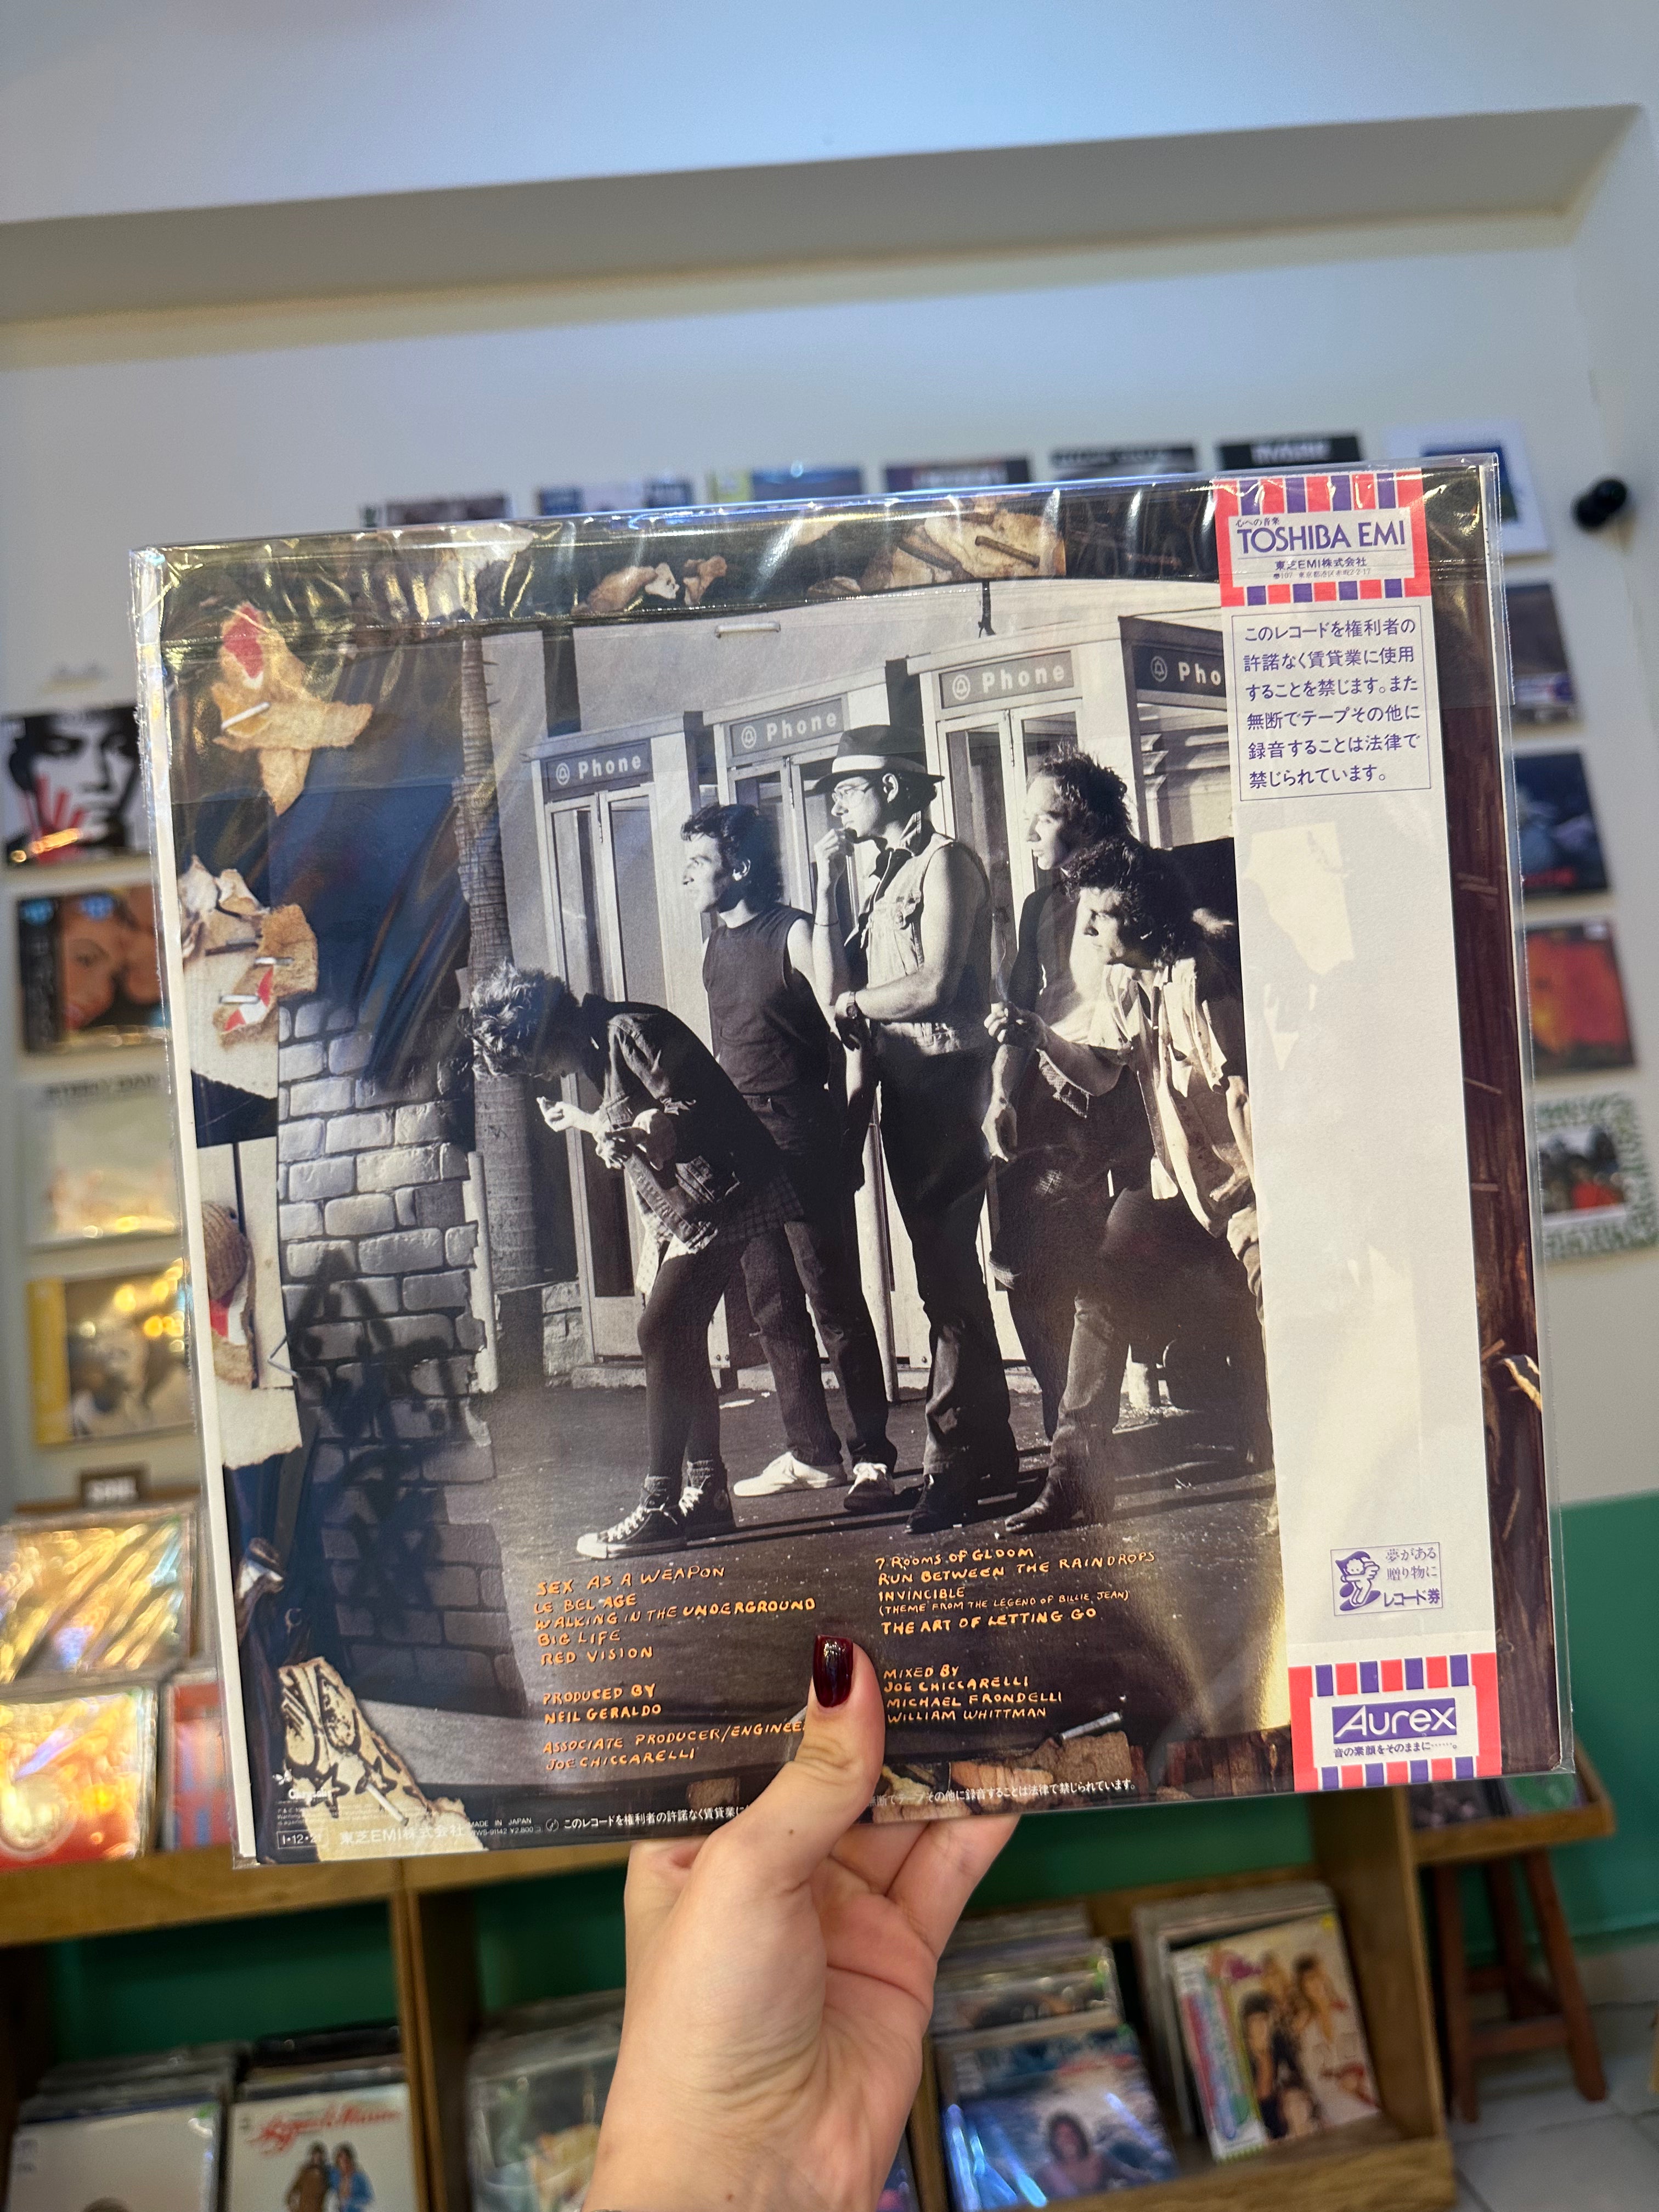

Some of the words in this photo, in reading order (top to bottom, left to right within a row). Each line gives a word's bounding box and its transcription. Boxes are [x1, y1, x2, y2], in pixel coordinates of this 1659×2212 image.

[1237, 523, 1352, 554] TOSHIBA
[1358, 520, 1406, 547] EMI
[1274, 557, 1367, 571] 東芝EMI株式会社
[1244, 618, 1415, 641] このレコードを権利者の
[1243, 646, 1414, 672] 許諾なく賃貸業に使用
[982, 665, 1064, 693] Phone
[1245, 675, 1418, 701] することを禁じます。また
[766, 713, 837, 742] Phone
[1246, 704, 1420, 731] 無断でテープその他に
[1248, 733, 1420, 760] 録音することは法律で
[578, 755, 641, 780] Phone
[1249, 764, 1386, 789] 禁じられています。
[875, 1557, 886, 1570] 7
[891, 1554, 942, 1569] ROOMS
[949, 1549, 968, 1562] OF
[972, 1548, 1034, 1561] GLOOM
[1385, 1547, 1436, 1562] 夢がある
[878, 1572, 913, 1586] RUN
[921, 1566, 1005, 1583] BETWEEN
[1017, 1561, 1050, 1573] THE
[1059, 1551, 1155, 1569] RAINDROPS
[1386, 1565, 1437, 1581] 贈り物に
[536, 1579, 573, 1596] SEX
[586, 1575, 613, 1590] AS
[620, 1572, 632, 1587] A
[641, 1565, 725, 1584] WEAPON
[534, 1601, 553, 1614] LE
[564, 1598, 595, 1613] BEL
[603, 1593, 637, 1609] AGE
[878, 1587, 966, 1602] INVINCIBLE
[879, 1602, 927, 1616] (THEME
[932, 1601, 964, 1613] FROM
[968, 1599, 988, 1609] THE
[993, 1597, 1036, 1607] LEGEND
[1040, 1595, 1054, 1604] OF
[1058, 1593, 1090, 1603] BILLIE
[1097, 1589, 1130, 1601] JEAN)
[1384, 1588, 1441, 1607] レコード券
[535, 1612, 618, 1630] WALKING
[624, 1611, 641, 1623] IN
[647, 1605, 678, 1622] THE
[682, 1597, 816, 1617] UNDERGROUND
[881, 1621, 915, 1635] THE
[920, 1619, 952, 1632] ART
[958, 1616, 981, 1629] OF
[988, 1610, 1063, 1626] LETTING
[1070, 1607, 1097, 1620] GO
[537, 1632, 571, 1647] BIG
[578, 1629, 620, 1645] LIFE
[540, 1651, 576, 1666] RED
[586, 1646, 653, 1663] VISION
[883, 1667, 934, 1679] MIXED
[940, 1663, 959, 1677] BY
[543, 1687, 623, 1705] PRODUCED
[631, 1683, 656, 1699] BY
[884, 1681, 912, 1693] JOE
[918, 1675, 1029, 1691] CHICCARELLI
[887, 1696, 962, 1708] MICHAEL
[969, 1691, 1062, 1705] FRONDELLI
[544, 1711, 581, 1725] NEIL
[586, 1703, 662, 1721] GERALDO
[887, 1710, 956, 1723] WILLIAM
[963, 1707, 1047, 1720] WHITTMAN
[1335, 1705, 1456, 1738] Aurex
[543, 1737, 624, 1754] ASSOCIATE
[635, 1720, 805, 1746] PRODUCER/ENGINEE
[546, 1757, 576, 1771] JOE
[579, 1748, 696, 1768] CHICCARELLI
[508, 1818, 532, 1826] JAPAN
